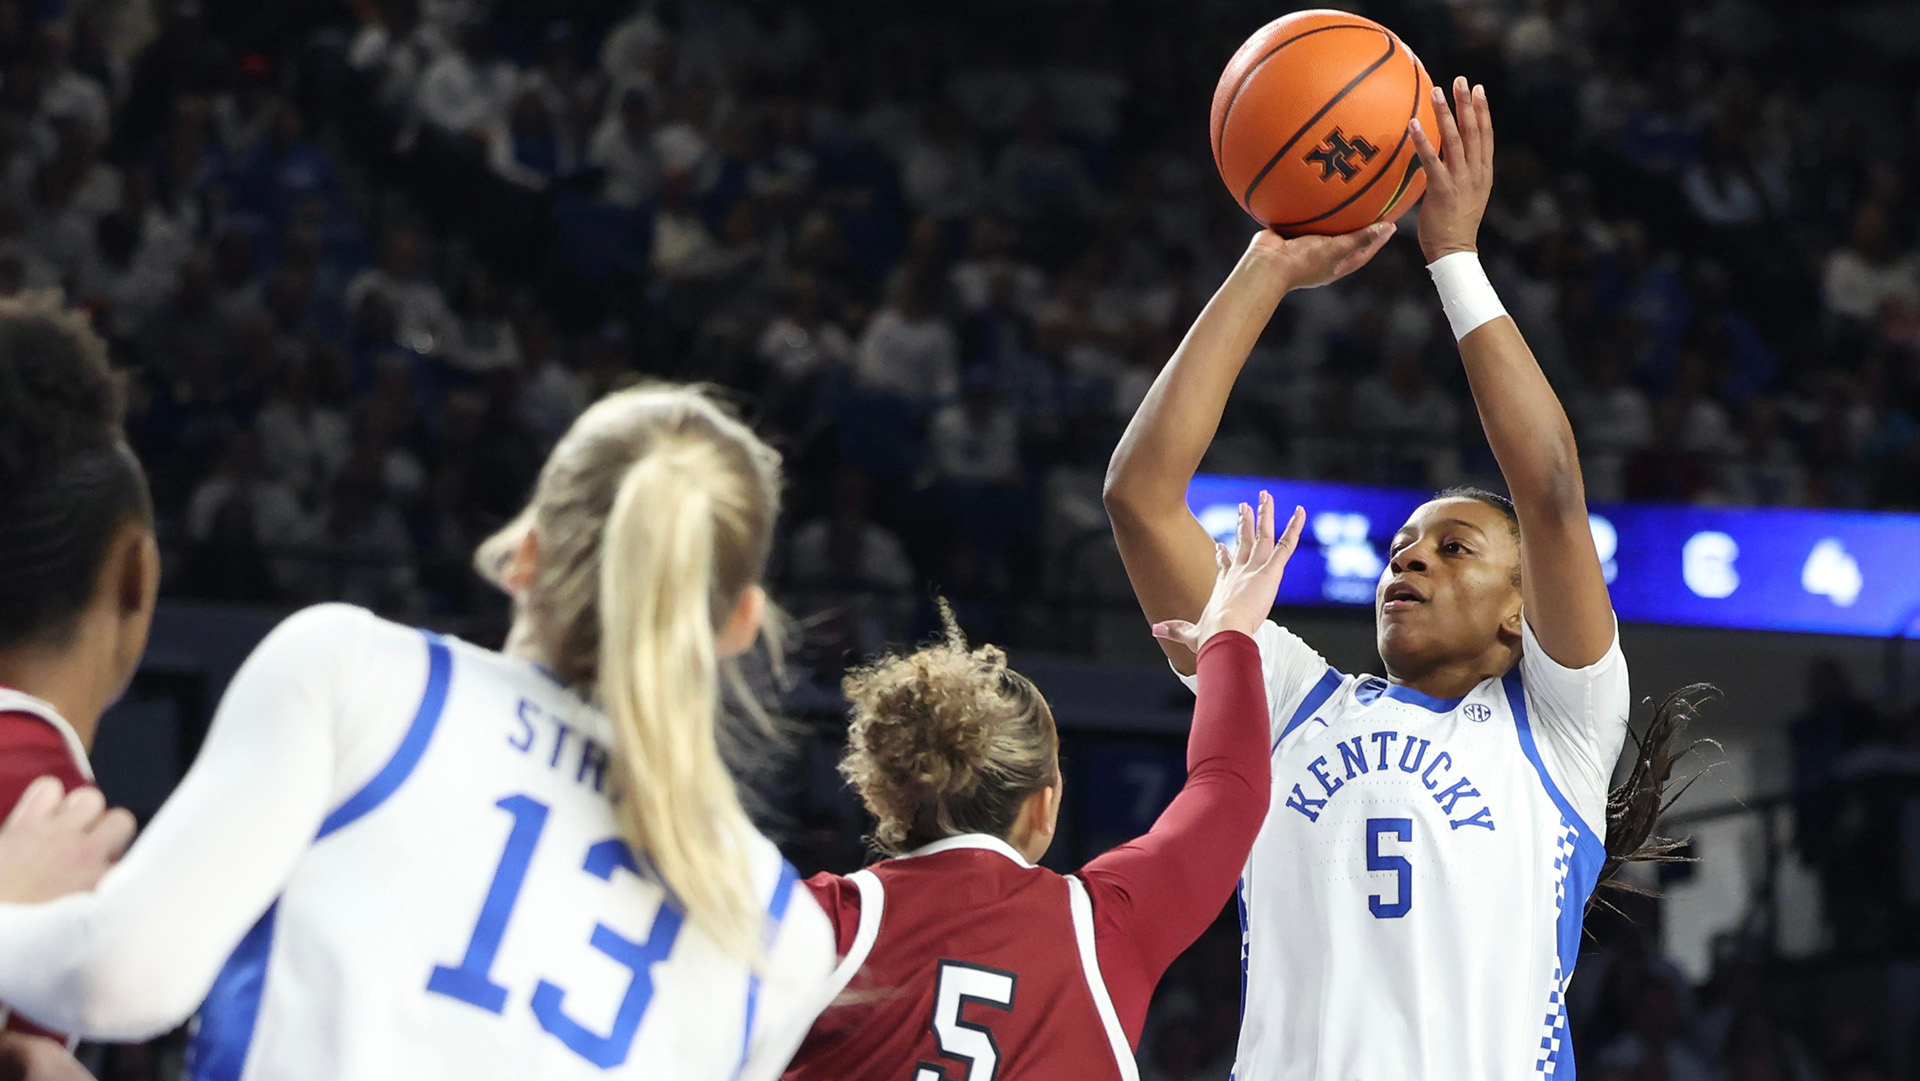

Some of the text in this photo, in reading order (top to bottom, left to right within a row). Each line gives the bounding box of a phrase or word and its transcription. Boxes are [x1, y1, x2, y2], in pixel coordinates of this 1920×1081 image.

[507, 698, 619, 802] STR
[1464, 703, 1491, 722] SEC
[1285, 730, 1496, 832] KENTUCKY
[1366, 817, 1413, 919] 5
[425, 793, 689, 1071] 13
[914, 958, 1019, 1081] 5
